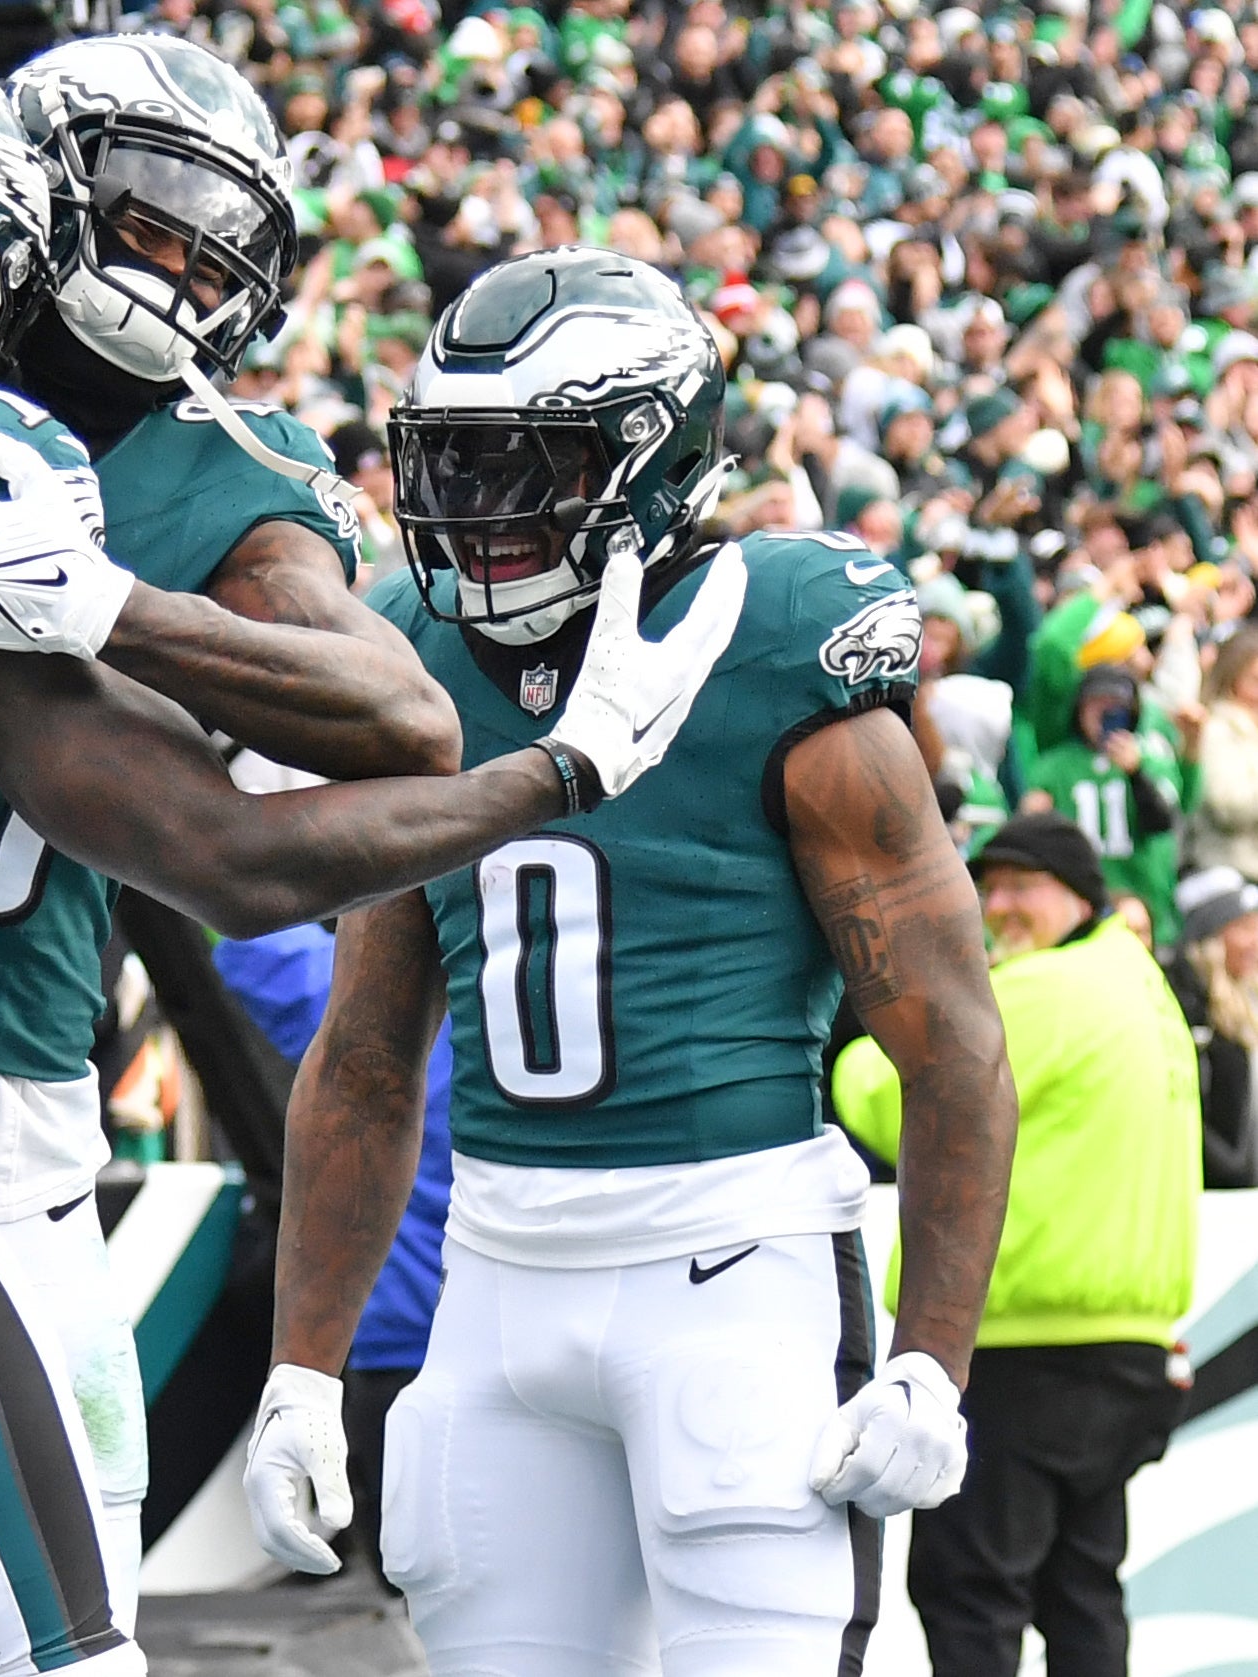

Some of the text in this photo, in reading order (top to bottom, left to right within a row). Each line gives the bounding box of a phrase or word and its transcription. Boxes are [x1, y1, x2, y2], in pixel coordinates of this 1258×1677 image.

[526, 686, 549, 705] NFL
[1072, 779, 1133, 857] 11
[474, 830, 617, 1108] 0
